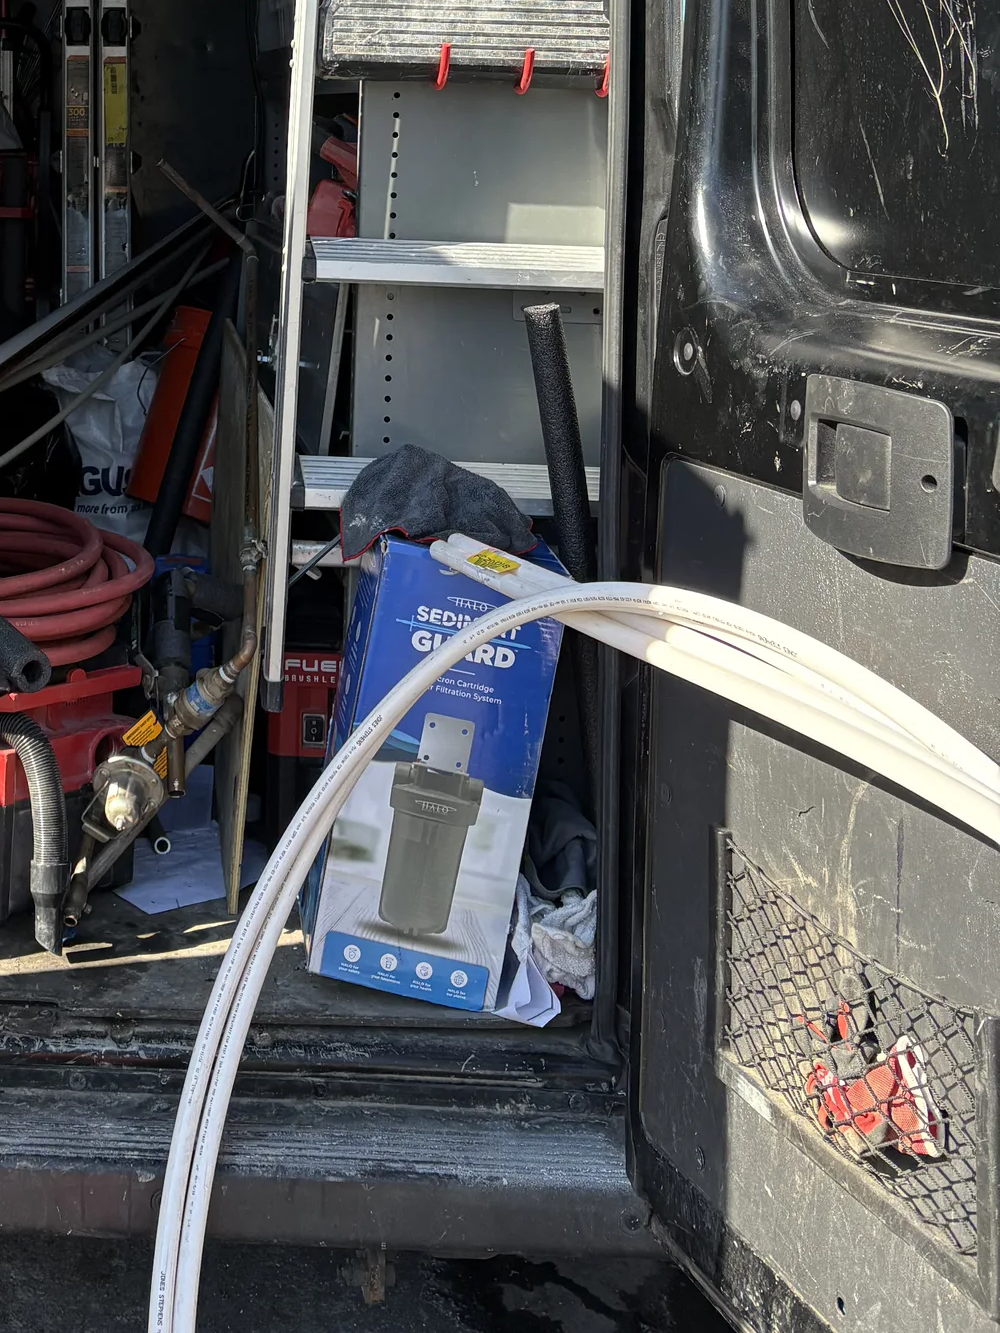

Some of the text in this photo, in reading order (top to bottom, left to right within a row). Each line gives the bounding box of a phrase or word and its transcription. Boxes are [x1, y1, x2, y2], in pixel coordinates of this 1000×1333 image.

[68, 108, 85, 116] 300
[76, 504, 99, 514] more
[101, 503, 128, 516] from
[455, 598, 488, 613] HALO
[457, 679, 494, 694] Cartridge
[436, 685, 472, 699] Filtration
[473, 693, 502, 705] System
[371, 714, 384, 728] JONES
[355, 727, 374, 746] STEPHENS
